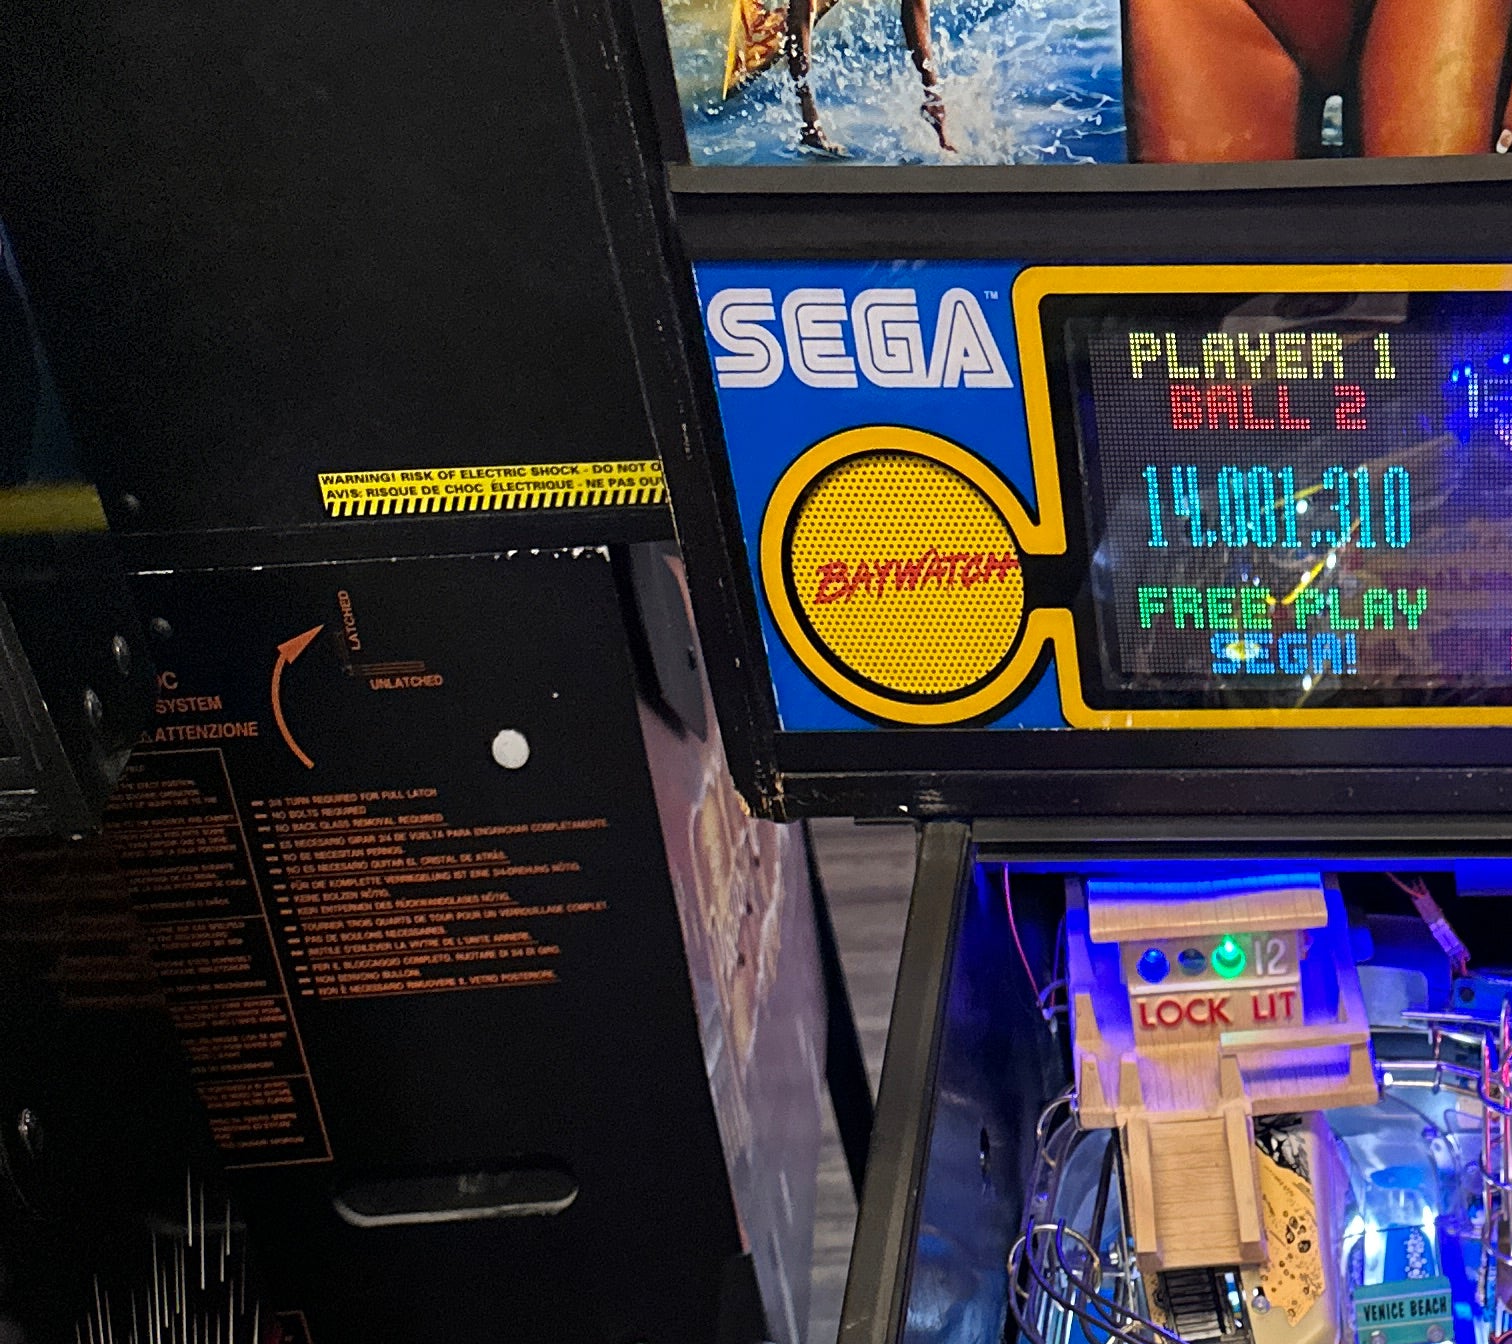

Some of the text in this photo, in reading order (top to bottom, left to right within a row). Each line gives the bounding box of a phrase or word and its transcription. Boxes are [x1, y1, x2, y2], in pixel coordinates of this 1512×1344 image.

[706, 287, 1014, 389] SEGA
[1129, 333, 1396, 379] PLAYER 1
[1170, 384, 1367, 430] BALL 2
[321, 463, 645, 485] WARNING! RISK ELECTRIC SHOCK NOT
[366, 486, 418, 498] RISQUE
[445, 483, 483, 495] CHOC
[491, 479, 574, 493] ÉLECTRIQUE
[608, 477, 636, 488] PAS
[815, 548, 1021, 607] BAYWATCH
[337, 590, 361, 650] LATCHED
[1137, 587, 1428, 630] FREE PLAY
[1210, 632, 1358, 674] SEGA!
[370, 674, 443, 690] UNLATCHED
[155, 696, 222, 714] SYSTEM
[155, 722, 259, 742] ATTENZIONE
[1254, 939, 1288, 977] 12
[1138, 991, 1297, 1031] LOCK LIT
[1363, 1296, 1447, 1321] VENICE BEACH
